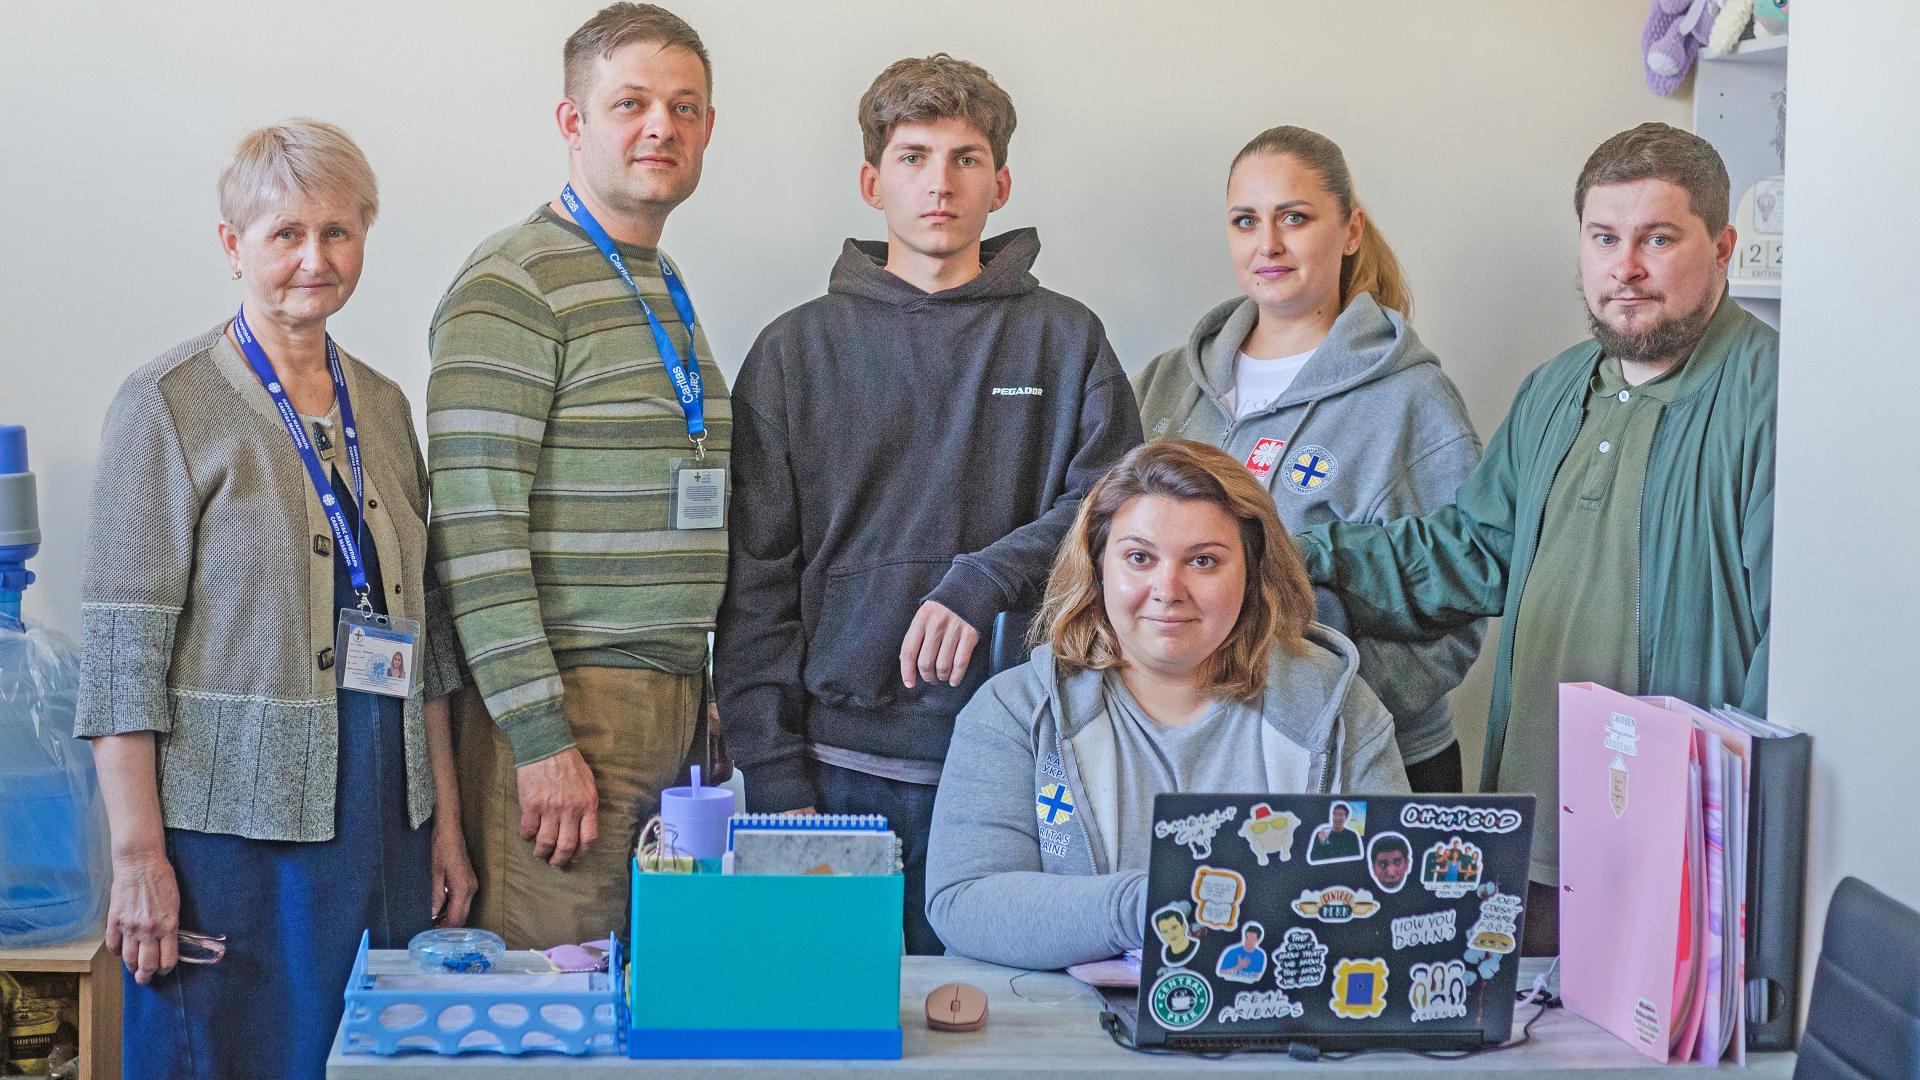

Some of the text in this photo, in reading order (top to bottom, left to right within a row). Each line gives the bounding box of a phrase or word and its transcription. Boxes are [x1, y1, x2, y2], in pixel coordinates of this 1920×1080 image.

[672, 366, 694, 404] Caritas
[991, 386, 1043, 396] PEGADOR
[1039, 841, 1067, 857] AINE
[1322, 906, 1349, 917] PERK
[1394, 912, 1455, 933] HOW YOU
[1157, 977, 1204, 1000] CENTRAL
[1237, 992, 1286, 1006] REAL
[1166, 1011, 1198, 1022] PERK
[1221, 1004, 1302, 1020] FRIENDS
